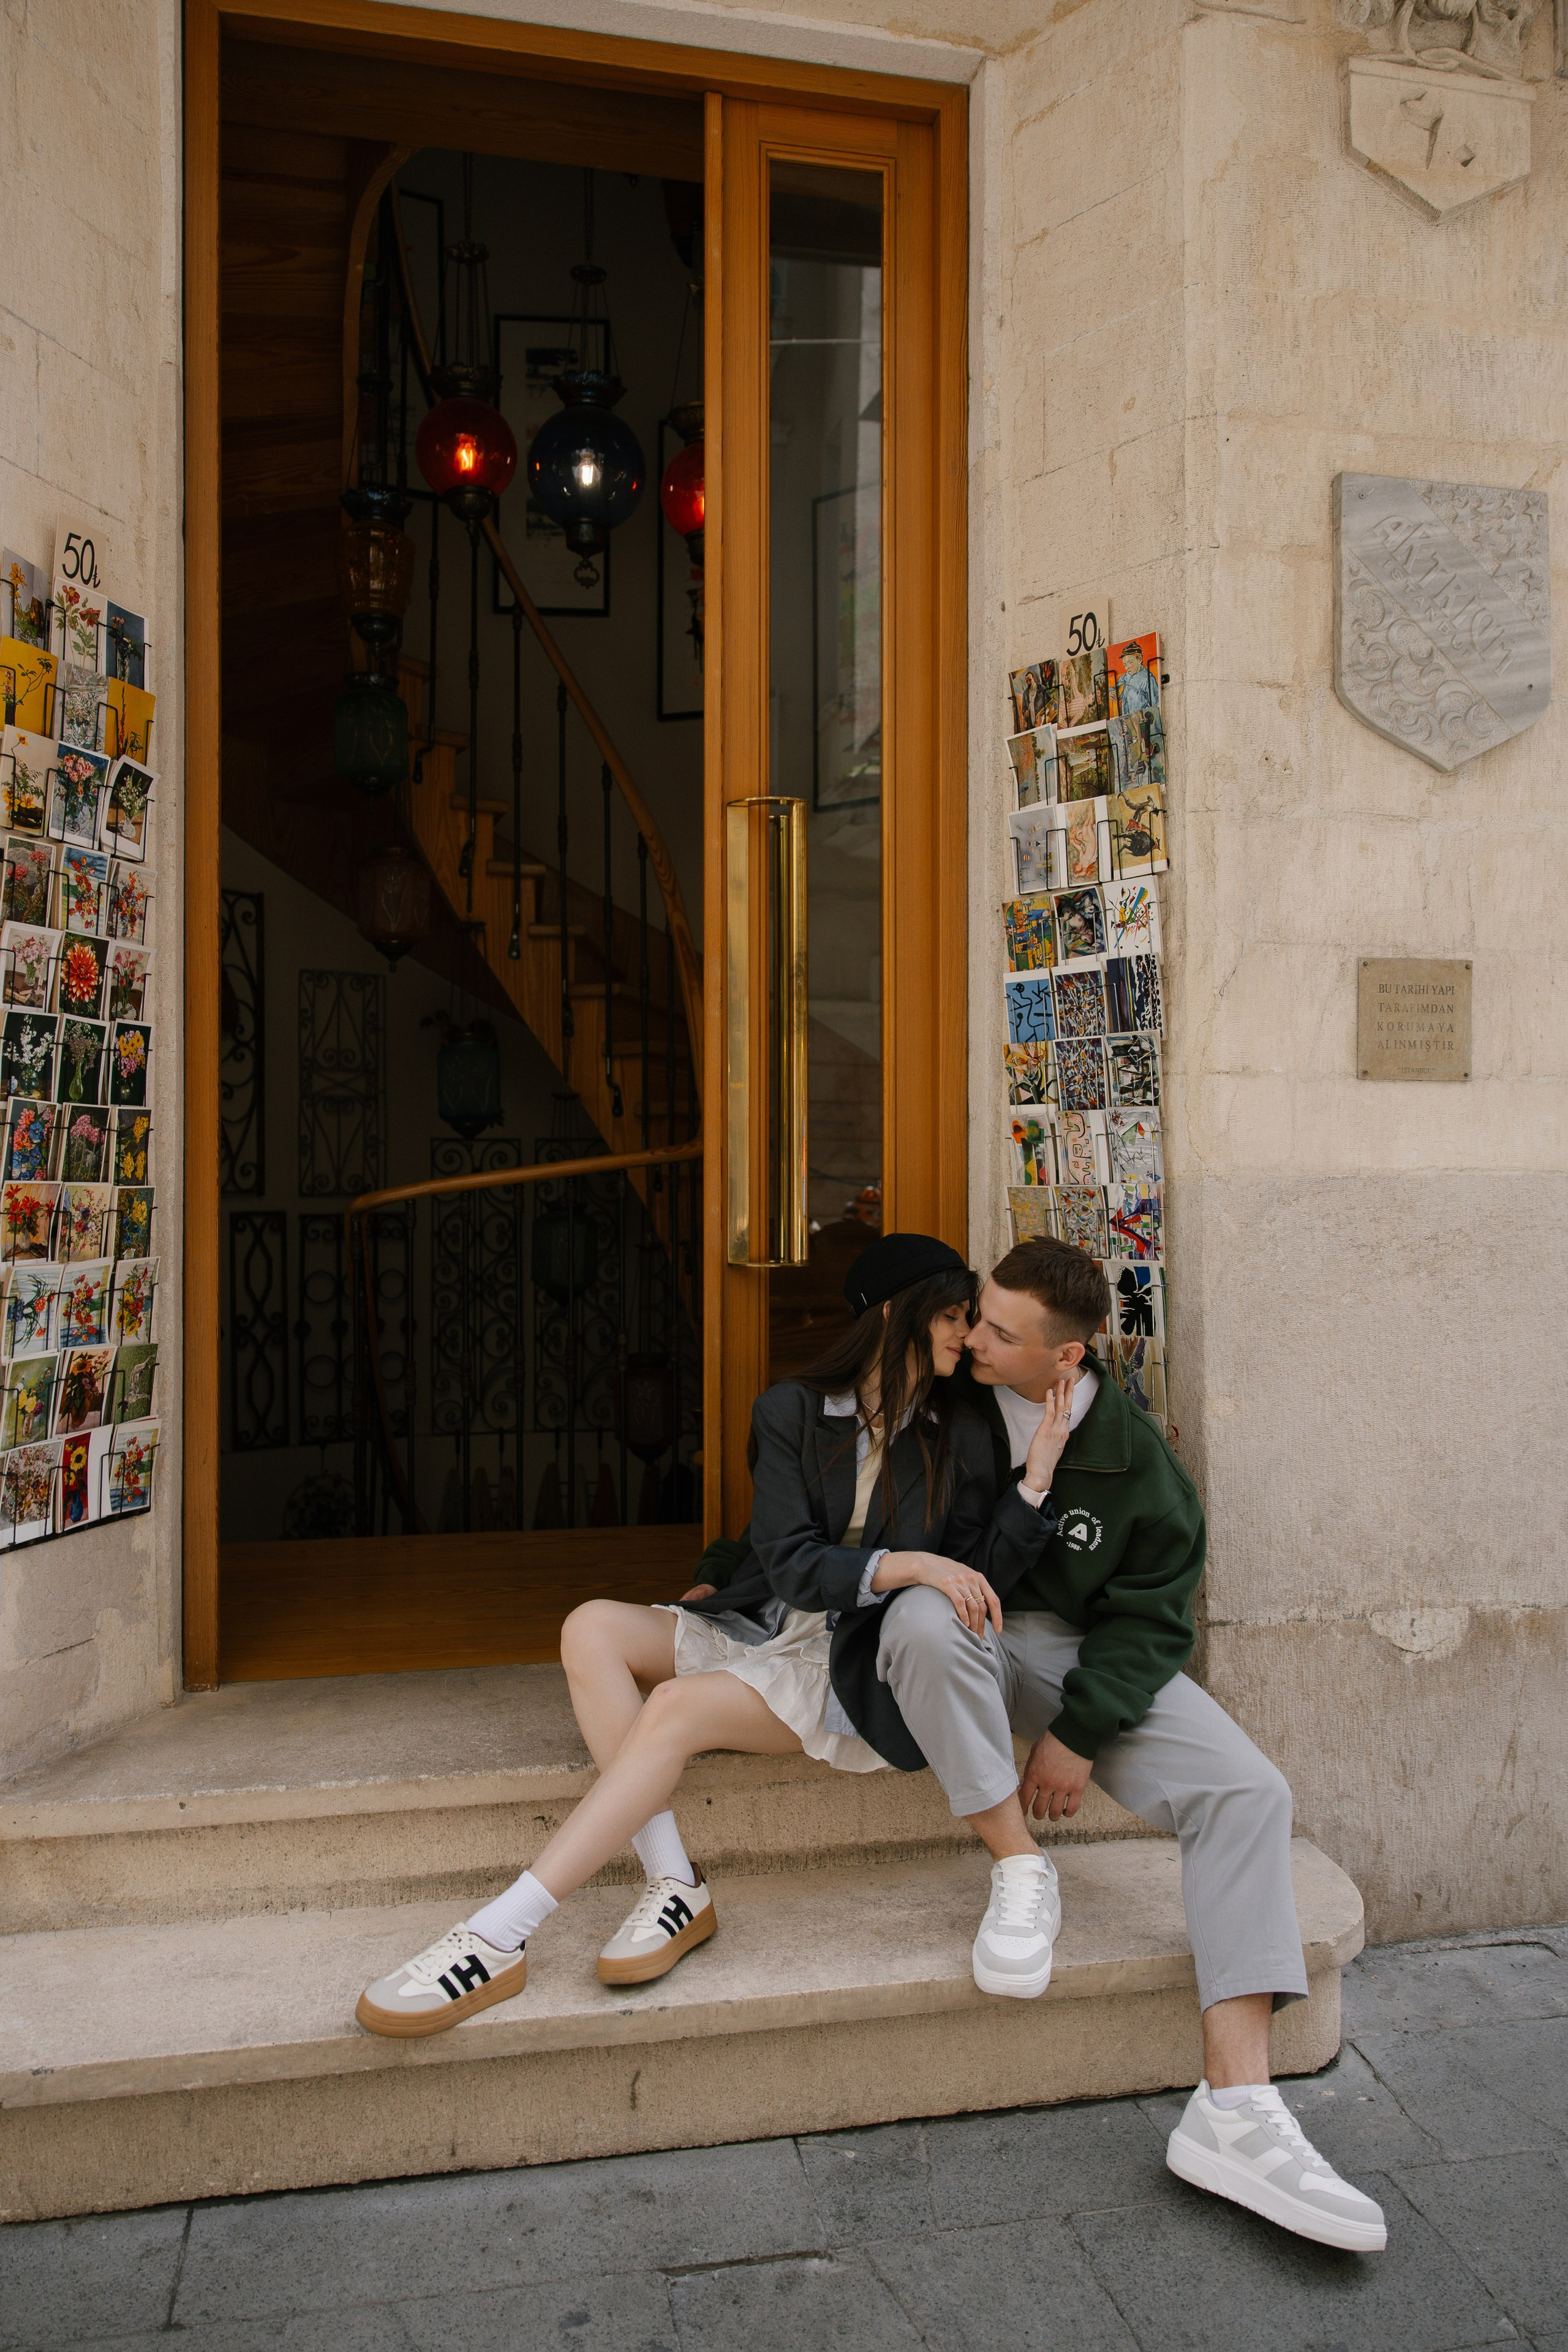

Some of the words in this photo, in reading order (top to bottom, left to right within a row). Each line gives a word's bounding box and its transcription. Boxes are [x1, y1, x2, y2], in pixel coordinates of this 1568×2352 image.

[1378, 984, 1392, 993] BU
[1394, 983, 1429, 995] TARİHİ
[1431, 985, 1455, 995] YAPI
[1378, 1002, 1453, 1014] TARAFIMDAN
[1376, 1021, 1454, 1033] KORUMAYA
[1377, 1039, 1453, 1052] ALINMIŞTIR
[1068, 1507, 1090, 1518] union
[1057, 1513, 1069, 1537] Active
[1091, 1517, 1101, 1525] of
[1088, 1526, 1103, 1551] leaders
